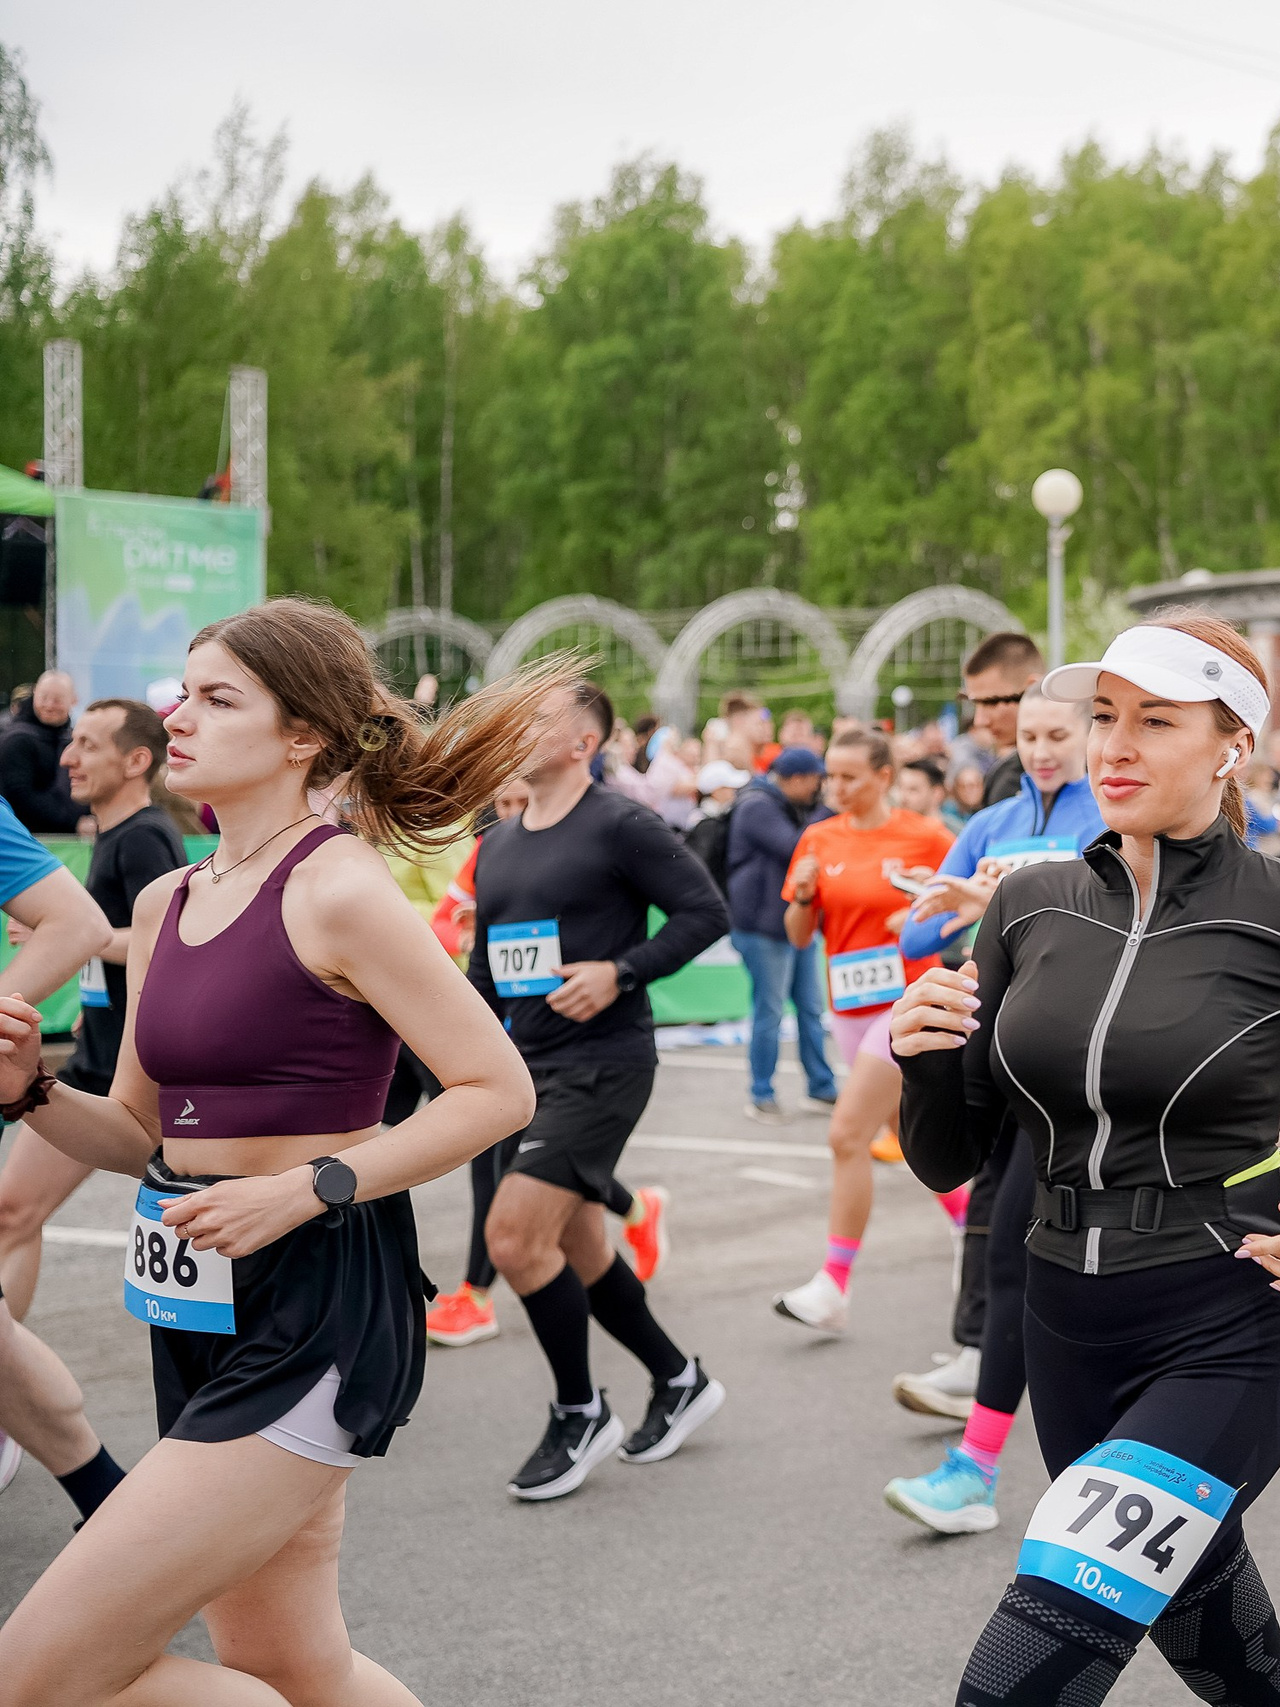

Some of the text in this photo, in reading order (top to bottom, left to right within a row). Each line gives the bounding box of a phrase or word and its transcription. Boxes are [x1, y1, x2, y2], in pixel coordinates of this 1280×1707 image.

[499, 946, 539, 974] 707
[841, 964, 894, 989] 1023
[134, 1224, 198, 1288] 886
[1110, 1450, 1134, 1462] СБЕР
[1065, 1477, 1189, 1575] 794
